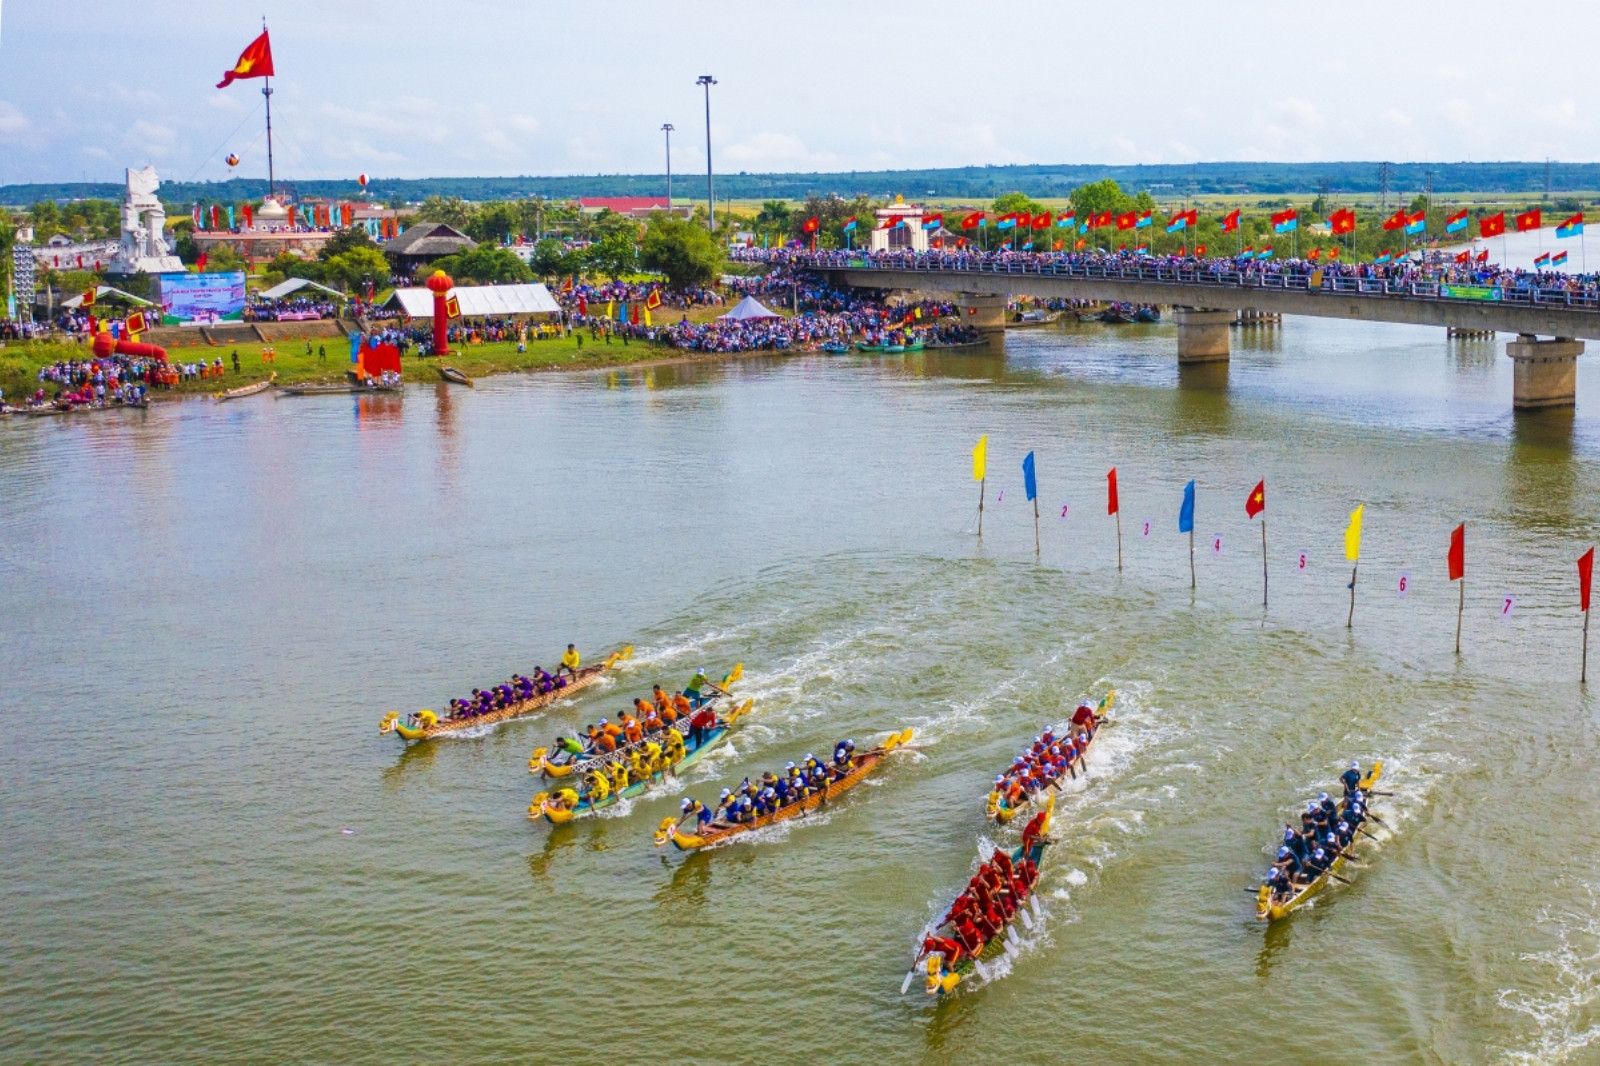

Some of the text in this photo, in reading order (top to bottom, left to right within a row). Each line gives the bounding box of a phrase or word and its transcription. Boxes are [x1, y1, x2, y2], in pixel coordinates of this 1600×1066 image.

[1061, 505, 1068, 517] 2
[1143, 522, 1149, 535] 3
[1214, 538, 1220, 551] 4
[1299, 554, 1305, 569] 5
[1399, 576, 1406, 592] 6
[1503, 598, 1512, 614] 7
